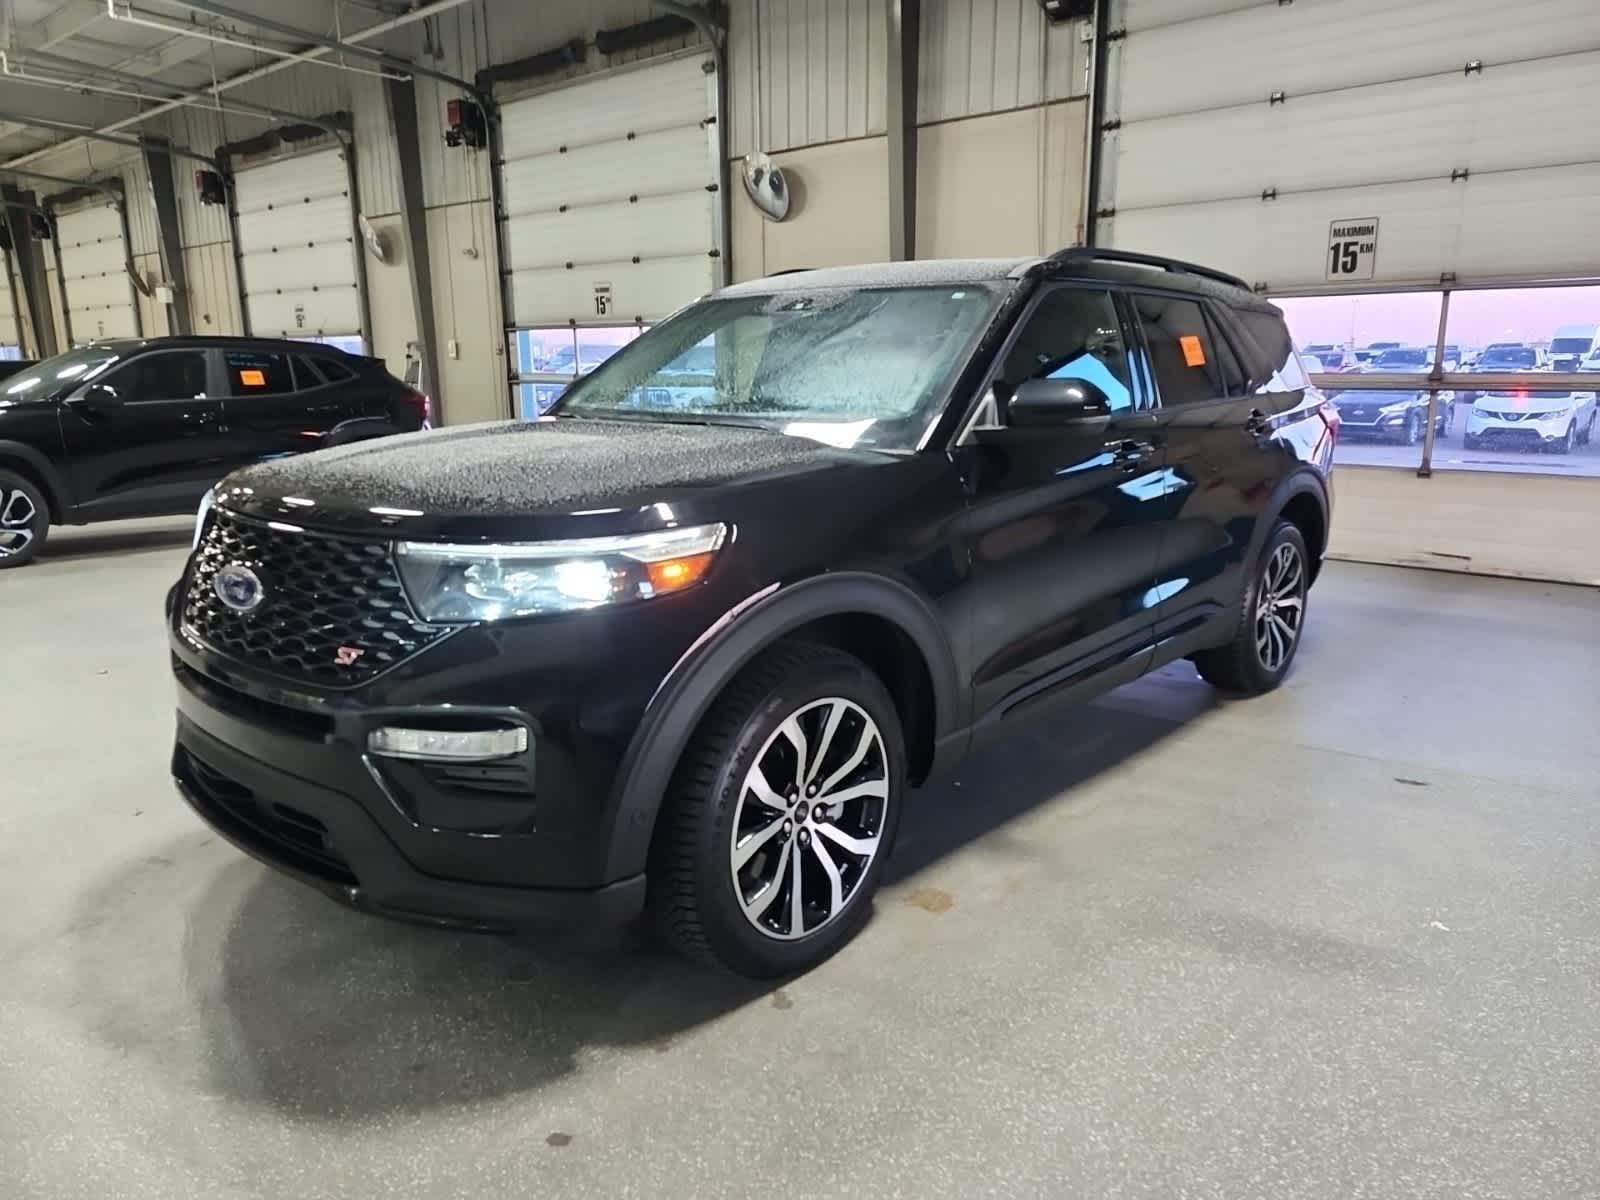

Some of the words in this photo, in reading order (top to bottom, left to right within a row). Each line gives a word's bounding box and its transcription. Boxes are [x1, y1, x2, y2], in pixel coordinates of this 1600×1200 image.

[1332, 225, 1374, 238] MAXIMUM
[1330, 241, 1359, 274] 15
[1359, 242, 1373, 254] KM
[595, 295, 606, 315] 15
